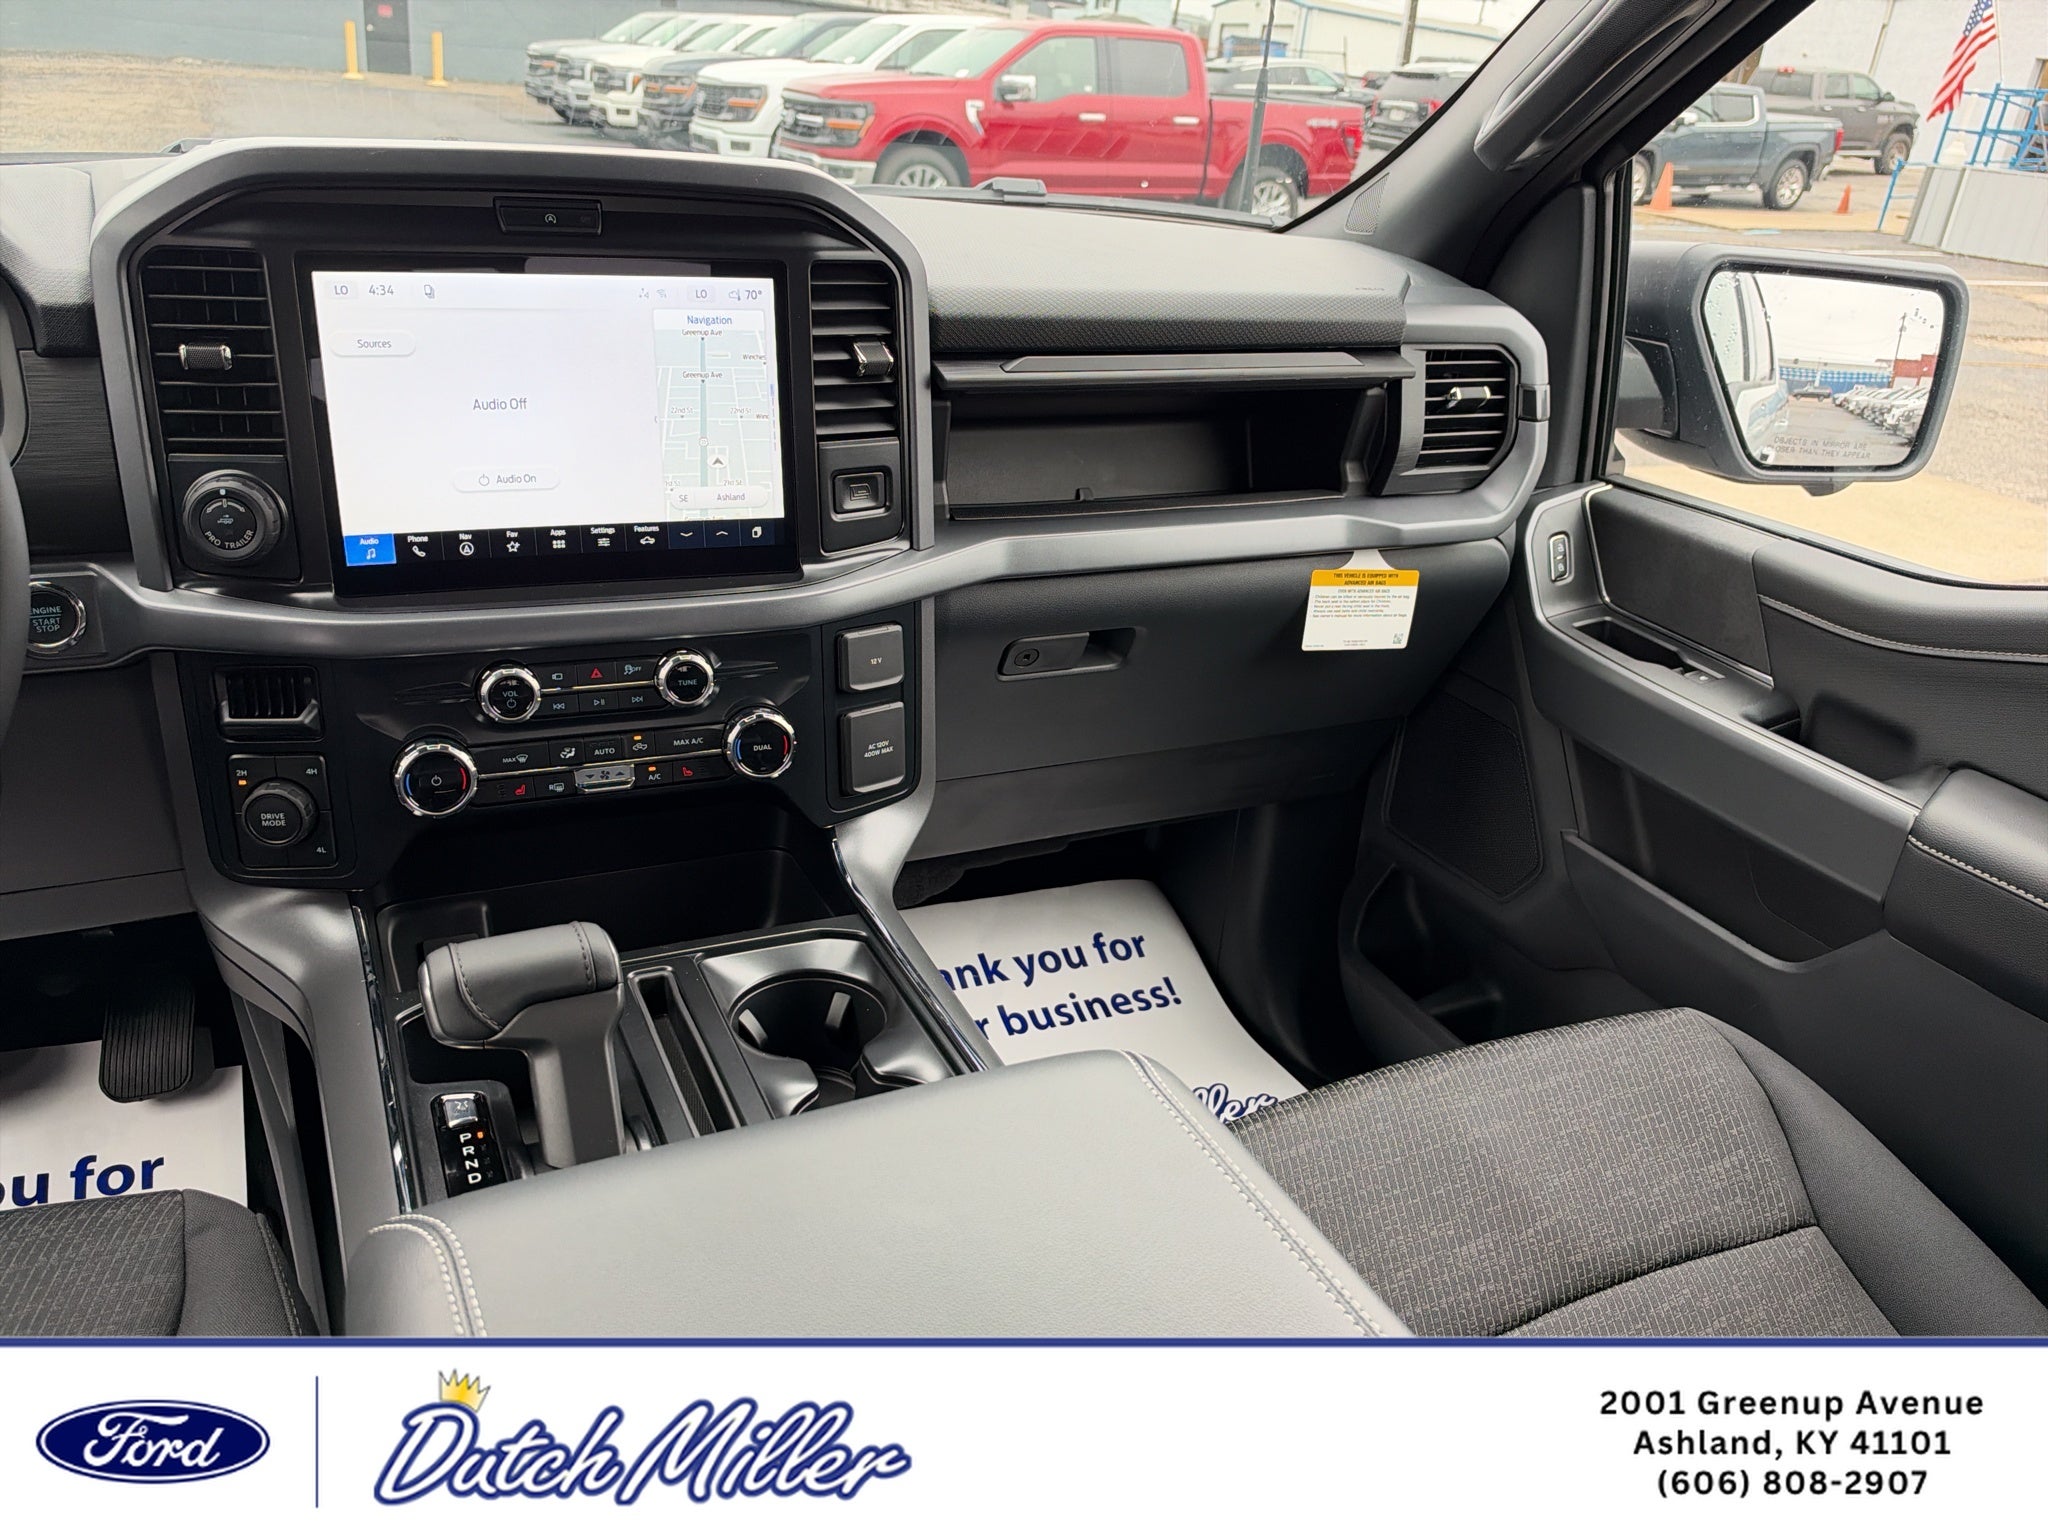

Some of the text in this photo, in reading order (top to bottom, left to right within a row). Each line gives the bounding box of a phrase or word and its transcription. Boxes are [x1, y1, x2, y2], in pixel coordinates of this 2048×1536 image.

[334, 285, 349, 296] LO
[368, 284, 394, 296] 4:34
[695, 289, 708, 299] LO
[686, 315, 733, 326] Navigation
[681, 329, 709, 337] Greenup
[357, 339, 392, 349] Sources
[682, 371, 709, 379] Greenup
[473, 397, 528, 411] Audio Off
[1774, 436, 1868, 451] OBJECTS IN MIRROR ARE
[1799, 447, 1818, 456] THAN
[1821, 449, 1840, 457] THEY
[1842, 450, 1871, 459] APPEAR
[496, 473, 537, 484] Audio On
[679, 494, 688, 502] SE
[716, 492, 745, 501] Ashland
[506, 530, 519, 538] Fav
[550, 528, 566, 537] Apps
[590, 526, 616, 535] Settings
[633, 525, 660, 533] Features
[205, 529, 254, 549] PRO TRAILER
[359, 537, 379, 546] Audio
[407, 535, 429, 543] Phone
[32, 618, 61, 626] START
[594, 748, 616, 756] AUTO
[753, 744, 772, 752] DUAL
[1012, 945, 1089, 988] you
[1092, 931, 1146, 964] for
[996, 976, 1182, 1036] business!
[460, 1132, 472, 1143] P
[462, 1145, 475, 1157] R
[465, 1158, 479, 1170] N
[70, 1154, 164, 1201] for
[467, 1172, 482, 1184] D
